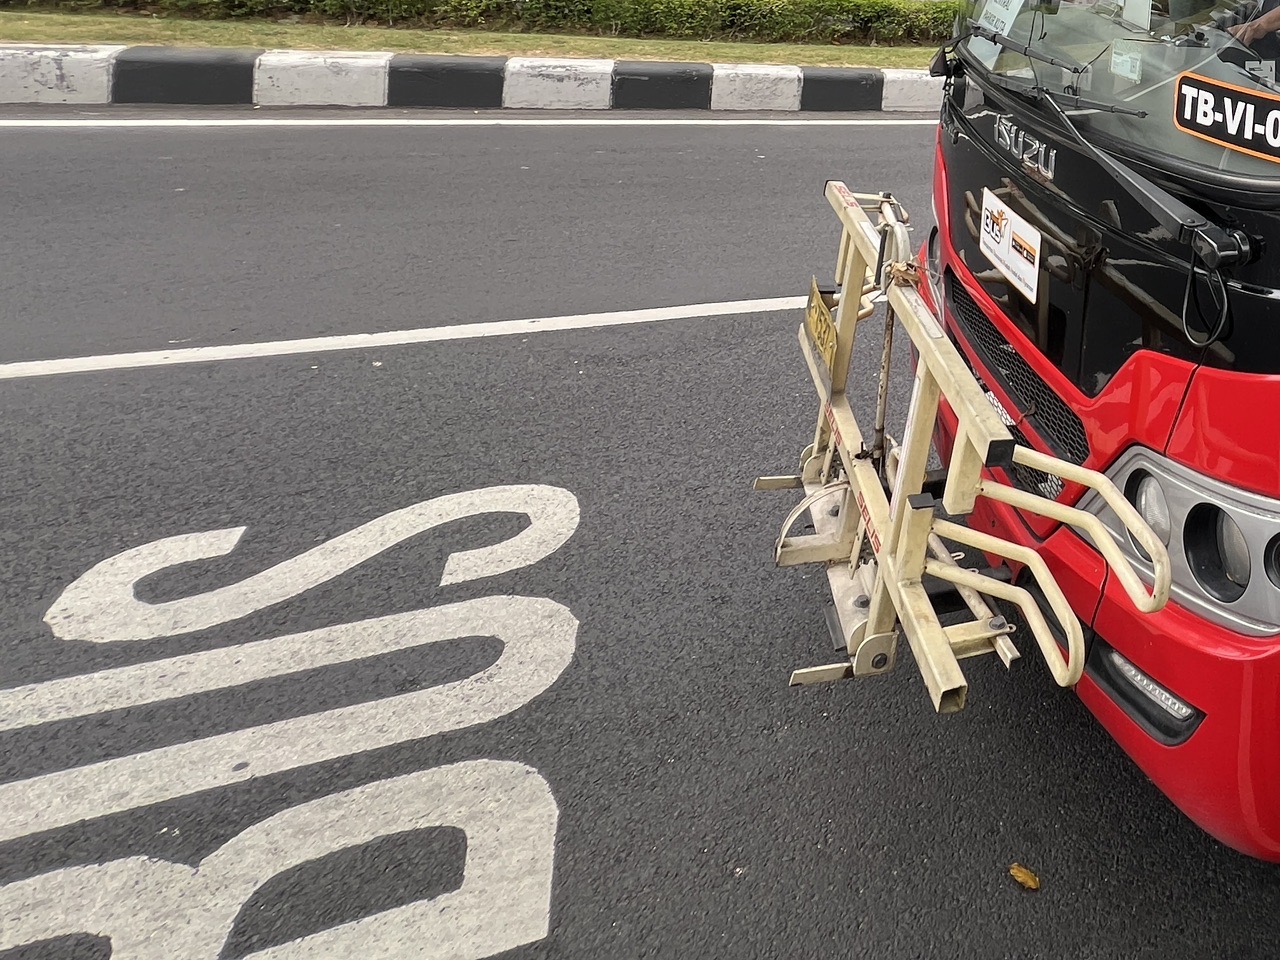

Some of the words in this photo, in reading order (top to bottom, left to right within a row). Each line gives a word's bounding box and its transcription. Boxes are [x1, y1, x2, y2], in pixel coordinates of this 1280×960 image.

[993, 114, 1057, 180] ISUZU
[834, 184, 859, 208] SELS
[857, 490, 882, 554] SELIS
[0, 483, 581, 960] BUS
